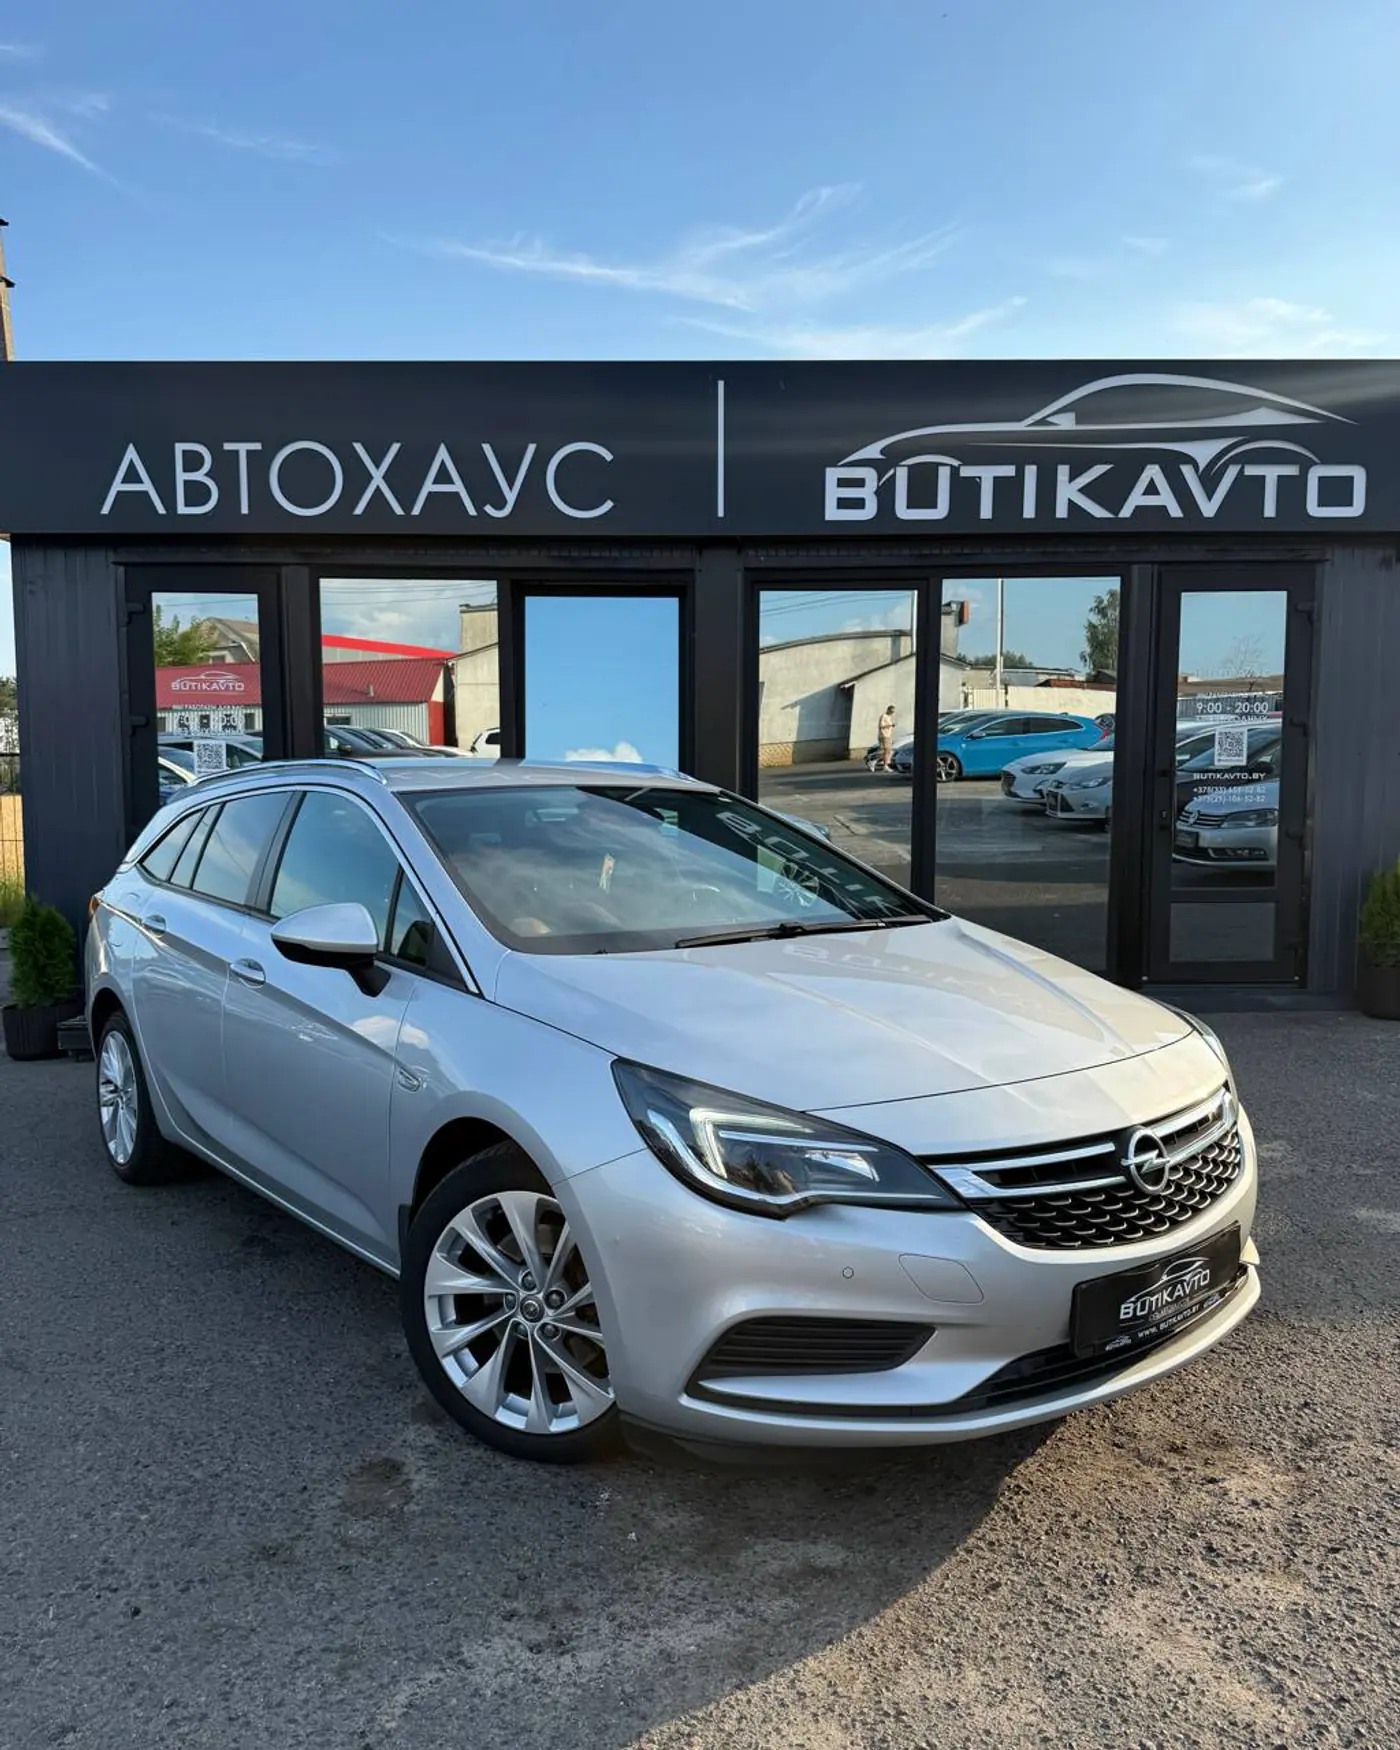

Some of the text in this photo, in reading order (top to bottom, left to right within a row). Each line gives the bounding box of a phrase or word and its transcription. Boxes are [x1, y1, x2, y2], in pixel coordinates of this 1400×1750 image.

[100, 440, 615, 519] АВТОХАУС
[824, 464, 1367, 522] BUTIKAVTO
[171, 682, 245, 691] BUTIKAVTO
[1196, 701, 1223, 713] 9:00
[1234, 701, 1269, 713] 20:00
[1193, 772, 1267, 780] BUTIKAVTO.BY
[1119, 1268, 1210, 1320] BUTIKAVTO
